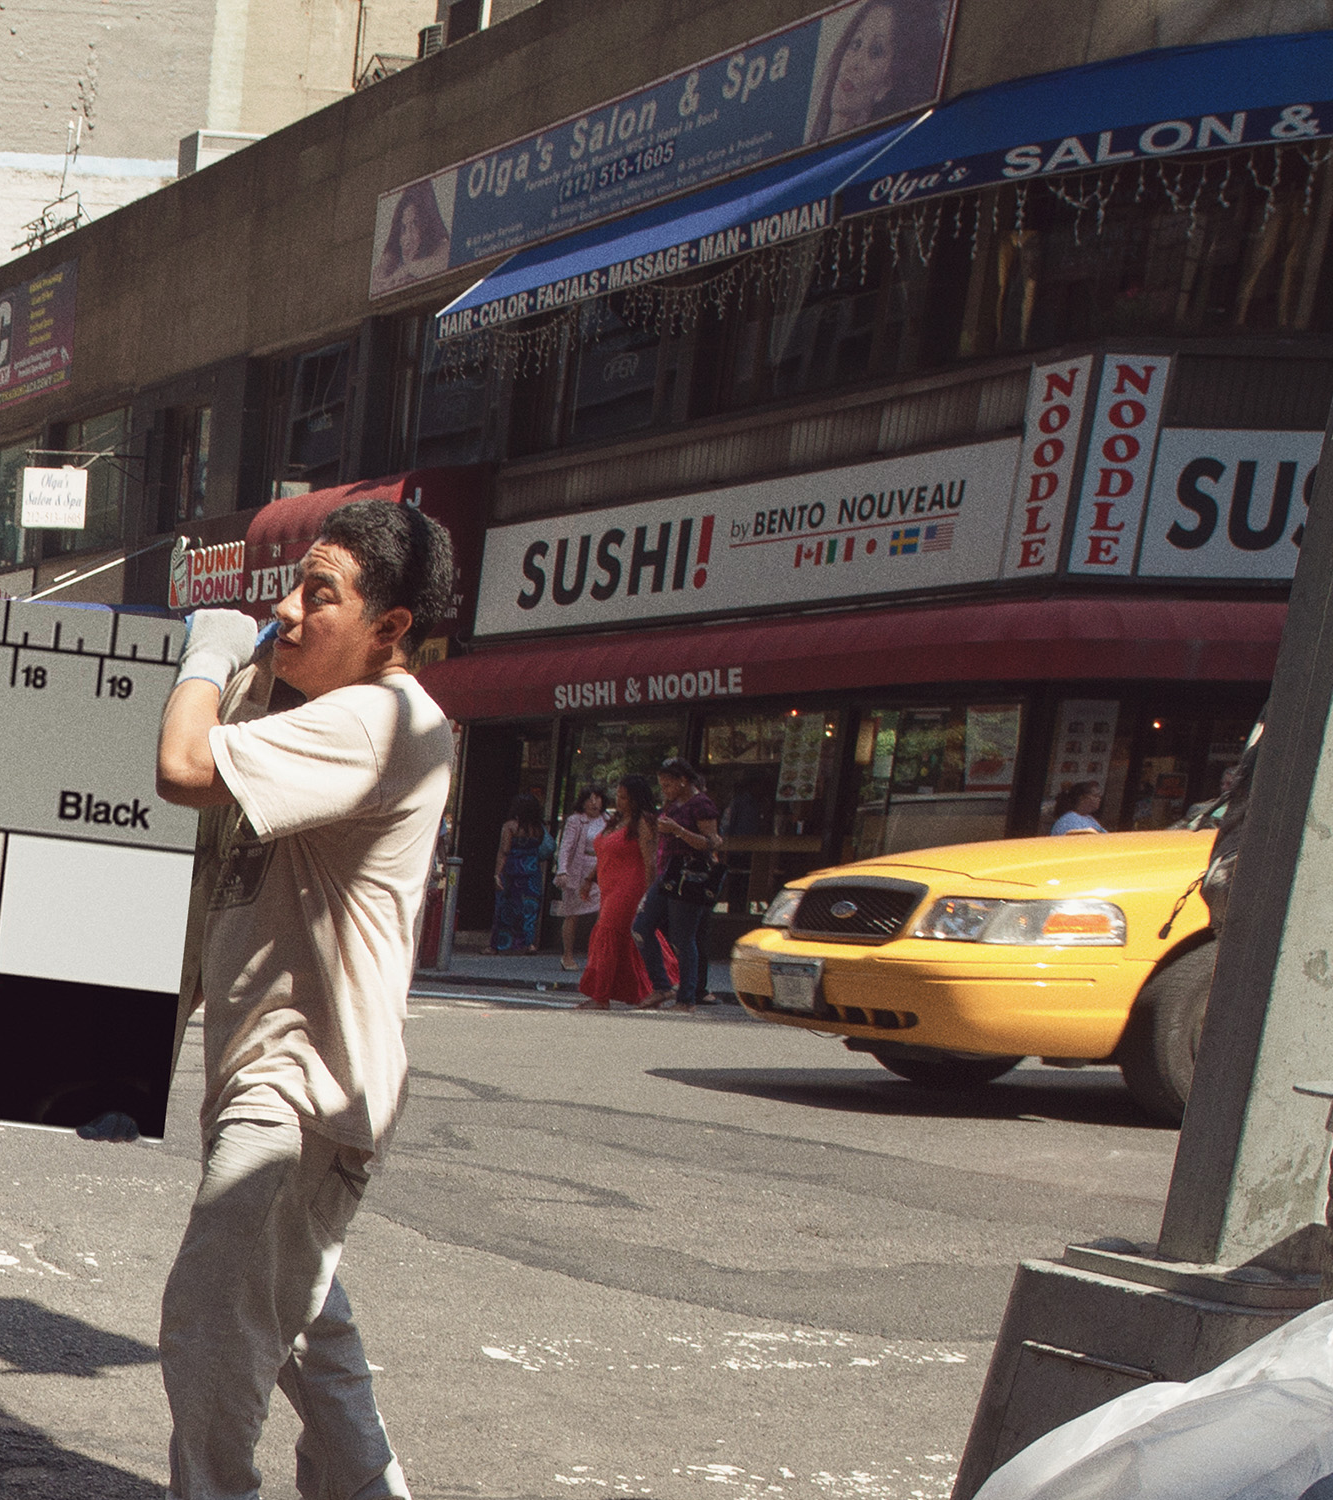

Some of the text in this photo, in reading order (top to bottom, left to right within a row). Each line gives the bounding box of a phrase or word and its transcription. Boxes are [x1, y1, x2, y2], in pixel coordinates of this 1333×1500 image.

[467, 136, 554, 199] Olga's
[569, 99, 657, 160] Salon
[678, 70, 700, 117] &
[721, 45, 790, 103] Spa
[869, 104, 1321, 203] Olga's SALON &
[598, 139, 674, 188] 513-1605
[438, 199, 827, 339] HAIR COLOR FACIALS MASSAGE MAN WOMAN
[25, 492, 52, 507] Salon
[65, 492, 82, 509] Spa
[41, 473, 69, 490] Olga's
[1017, 367, 1080, 569] NOODLE
[1084, 364, 1158, 566] NOODLE
[516, 480, 967, 610] SUSHI! by BENTO NOUVEAU
[21, 665, 47, 688] 18
[106, 674, 133, 698] 19
[554, 667, 744, 710] SUSHI & NOODLE
[59, 791, 150, 830] Black
